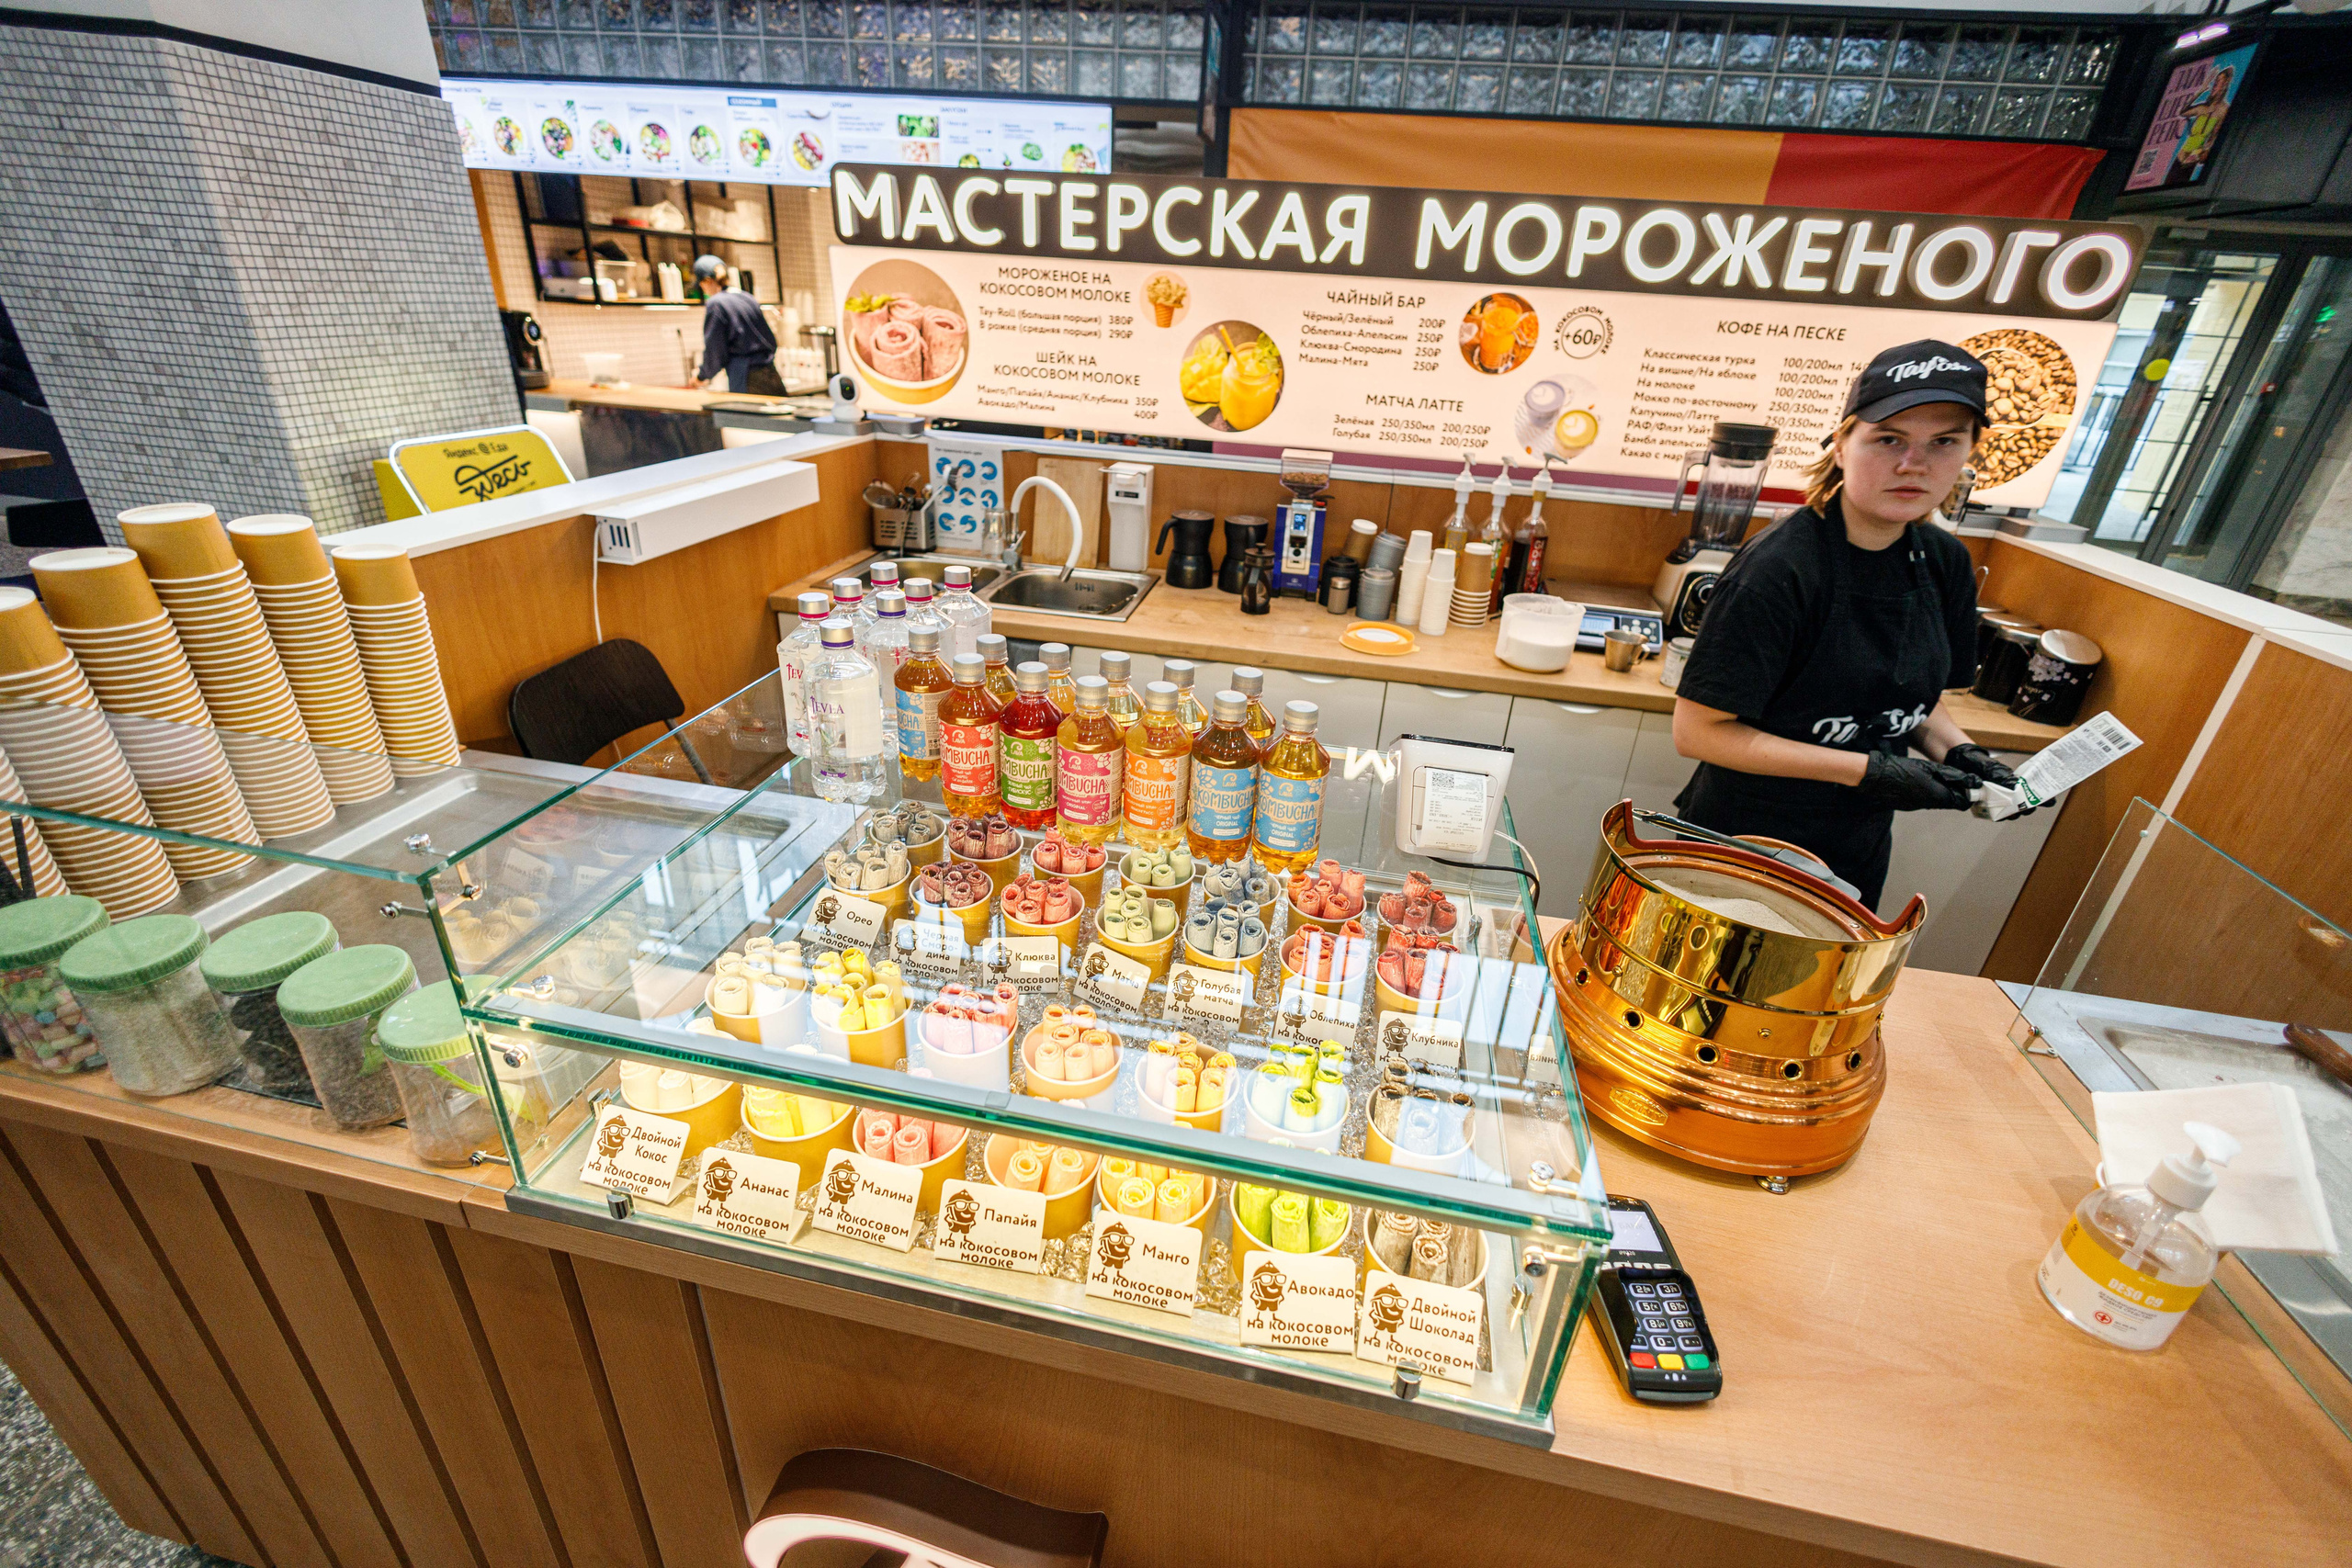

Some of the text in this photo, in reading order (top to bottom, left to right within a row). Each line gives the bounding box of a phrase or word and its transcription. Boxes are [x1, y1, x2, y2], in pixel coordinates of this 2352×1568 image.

[834, 169, 2132, 310] МАСТЕРСКАЯ МОРОЖЕНОГО
[998, 267, 1112, 285] МОРОЖЕНОЕ НА
[979, 282, 1131, 303] КОКОСОВОМ МОЛОКЕ
[1327, 288, 1426, 309] ЧАЙНЫЙ БАР
[1301, 325, 1408, 341] Облепиха-Апельсин
[1717, 320, 1847, 342] КОФЕ НА ПЕСКЕ
[1300, 339, 1402, 355] Клюква-Смородина
[1644, 347, 1721, 363] Классическая
[1724, 354, 1757, 366] турка
[1035, 350, 1098, 367] ШЕЙК НА
[1299, 354, 1369, 367] Малина-Мята
[993, 364, 1141, 387] КОКОСОВОМ МОЛОКЕ
[1640, 363, 1656, 374] На
[1717, 368, 1757, 380] яблоке
[1636, 377, 1651, 387] На
[1655, 380, 1696, 390] молоке
[1365, 394, 1464, 412] МАТЧА ЛАТТЕ
[1634, 391, 1670, 404] Мокко
[1673, 395, 1758, 410] по-восточному
[1333, 414, 1374, 426] Зелёная
[1630, 405, 1720, 422] Капучино/Латте
[1332, 427, 1371, 440] Голубая
[1620, 446, 1652, 459] Какао
[786, 662, 804, 682] TEV
[941, 745, 990, 766] OMBUCHA
[1001, 758, 1047, 779] OMBUCHA
[1057, 772, 1105, 794] OMBUCHA
[1125, 775, 1170, 798] OMBUCHA
[846, 910, 873, 926] Орео
[820, 928, 872, 950] кокосовом
[923, 928, 959, 942] Черная
[922, 938, 958, 952] Сморо-
[925, 952, 950, 961] дина
[1015, 953, 1056, 962] Клюква
[905, 960, 958, 976] кокосовом
[1001, 976, 1058, 985] кокосовом
[1112, 968, 1139, 989] Матча
[1200, 979, 1241, 996] Голубая
[1078, 980, 1137, 1013] на кокосовом
[1204, 995, 1234, 1006] матча
[1168, 1004, 1180, 1012] на
[1182, 1007, 1239, 1024] кокосовом
[1310, 1010, 1355, 1029] Облепиха
[1278, 1029, 1290, 1037] на
[1411, 1032, 1459, 1048] Клубника
[630, 1126, 681, 1149] Двойной
[635, 1145, 668, 1164] Кокос
[587, 1161, 671, 1190] на кокосовом
[740, 1177, 789, 1199] Ананас
[861, 1179, 913, 1204] Малина
[697, 1204, 789, 1232] на кокосовом
[819, 1207, 909, 1237] на кокосовом
[984, 1208, 1037, 1228] Папайя
[717, 1220, 766, 1238] молоке
[837, 1224, 886, 1244] молоке
[940, 1238, 1038, 1262] на кокосовом
[1142, 1244, 1190, 1266] Манго
[960, 1253, 1014, 1269] молоке
[1091, 1271, 1193, 1302] на кокосовом
[1287, 1280, 1354, 1299] Авокадо
[2108, 1278, 2143, 1302] DESO
[1114, 1289, 1169, 1309] молоке
[1411, 1298, 1476, 1325] Двойной
[1247, 1318, 1353, 1337] на кокосовом
[1409, 1316, 1475, 1346] Шоколад
[1271, 1334, 1329, 1348] молоке
[1363, 1336, 1475, 1371] на кокосовом
